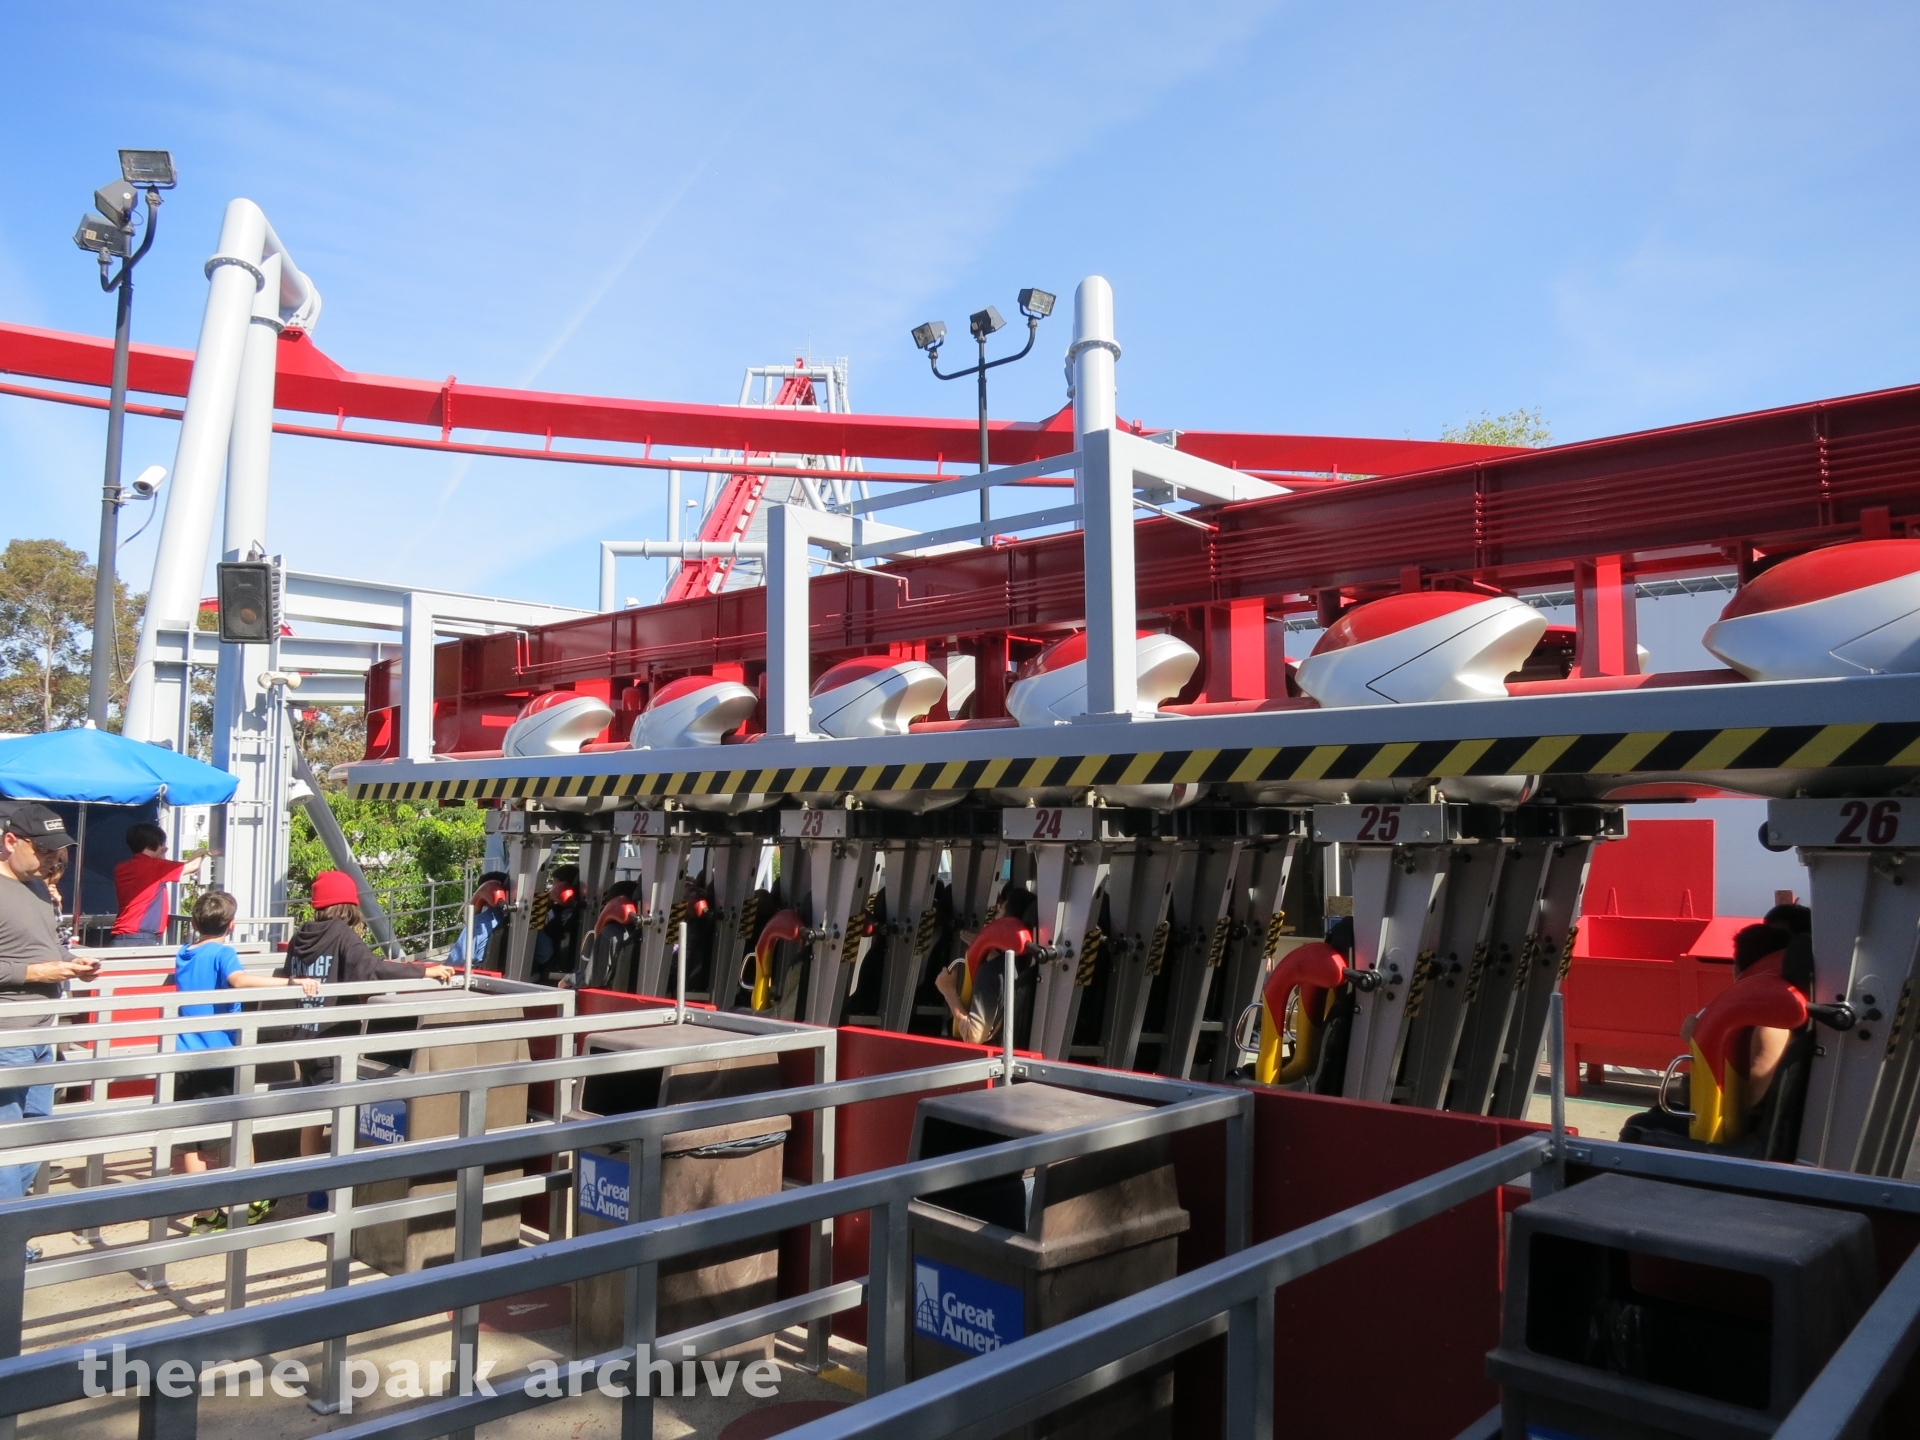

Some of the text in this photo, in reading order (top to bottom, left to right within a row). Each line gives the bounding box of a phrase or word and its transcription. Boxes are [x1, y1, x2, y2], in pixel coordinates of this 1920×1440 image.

[498, 811, 511, 831] 21
[632, 812, 650, 835] 22
[800, 810, 824, 837] 23
[1032, 809, 1063, 839] 24
[1356, 805, 1401, 841] 25
[1834, 800, 1901, 845] 26
[371, 1107, 395, 1129] Great
[370, 1121, 405, 1144] America
[595, 1194, 629, 1221] Amer
[941, 1291, 995, 1333] Great
[940, 1314, 1003, 1354] Ameri
